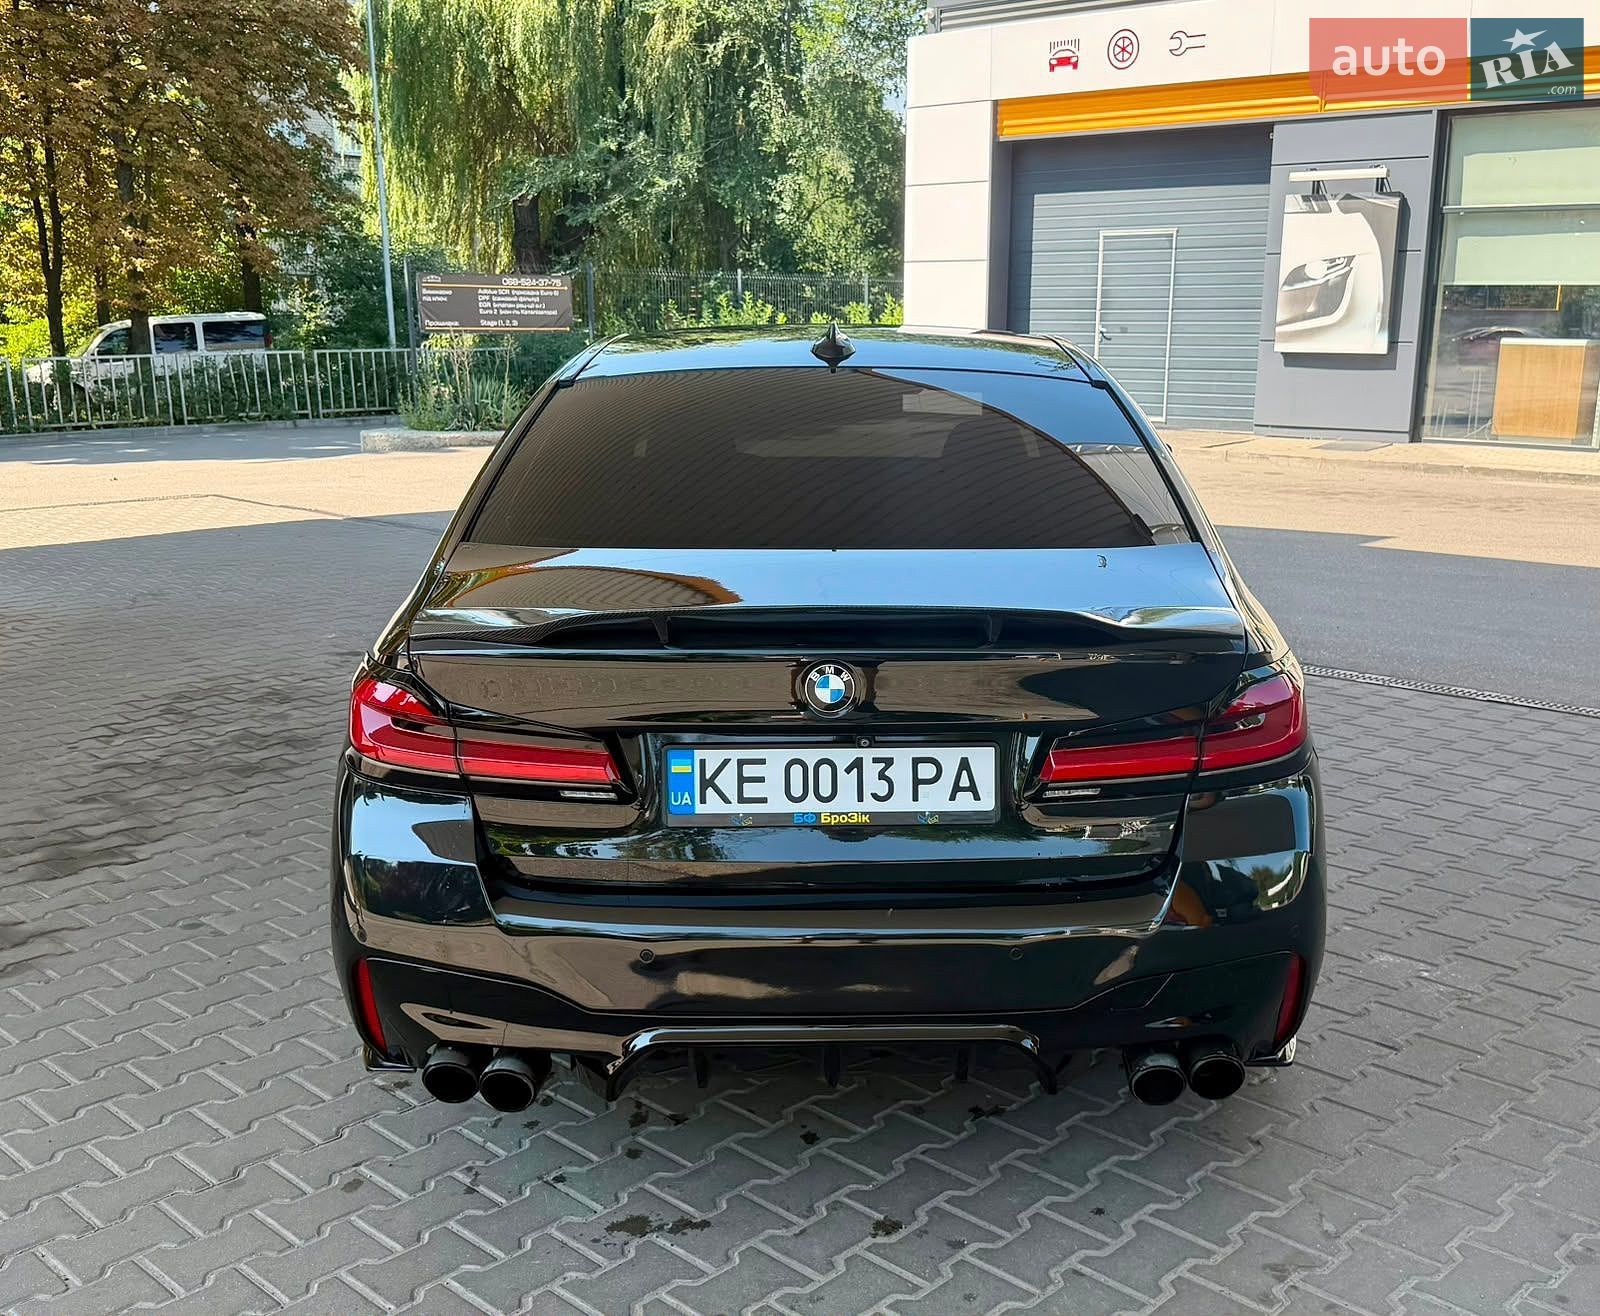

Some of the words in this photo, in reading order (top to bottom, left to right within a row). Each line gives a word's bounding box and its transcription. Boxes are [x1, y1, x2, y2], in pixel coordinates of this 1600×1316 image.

[810, 666, 851, 682] BMW
[699, 758, 768, 805] KE
[784, 757, 896, 804] 0013
[911, 756, 982, 803] PA
[671, 791, 692, 806] UA
[793, 811, 817, 824] БФ
[820, 812, 871, 825] БроЗік
